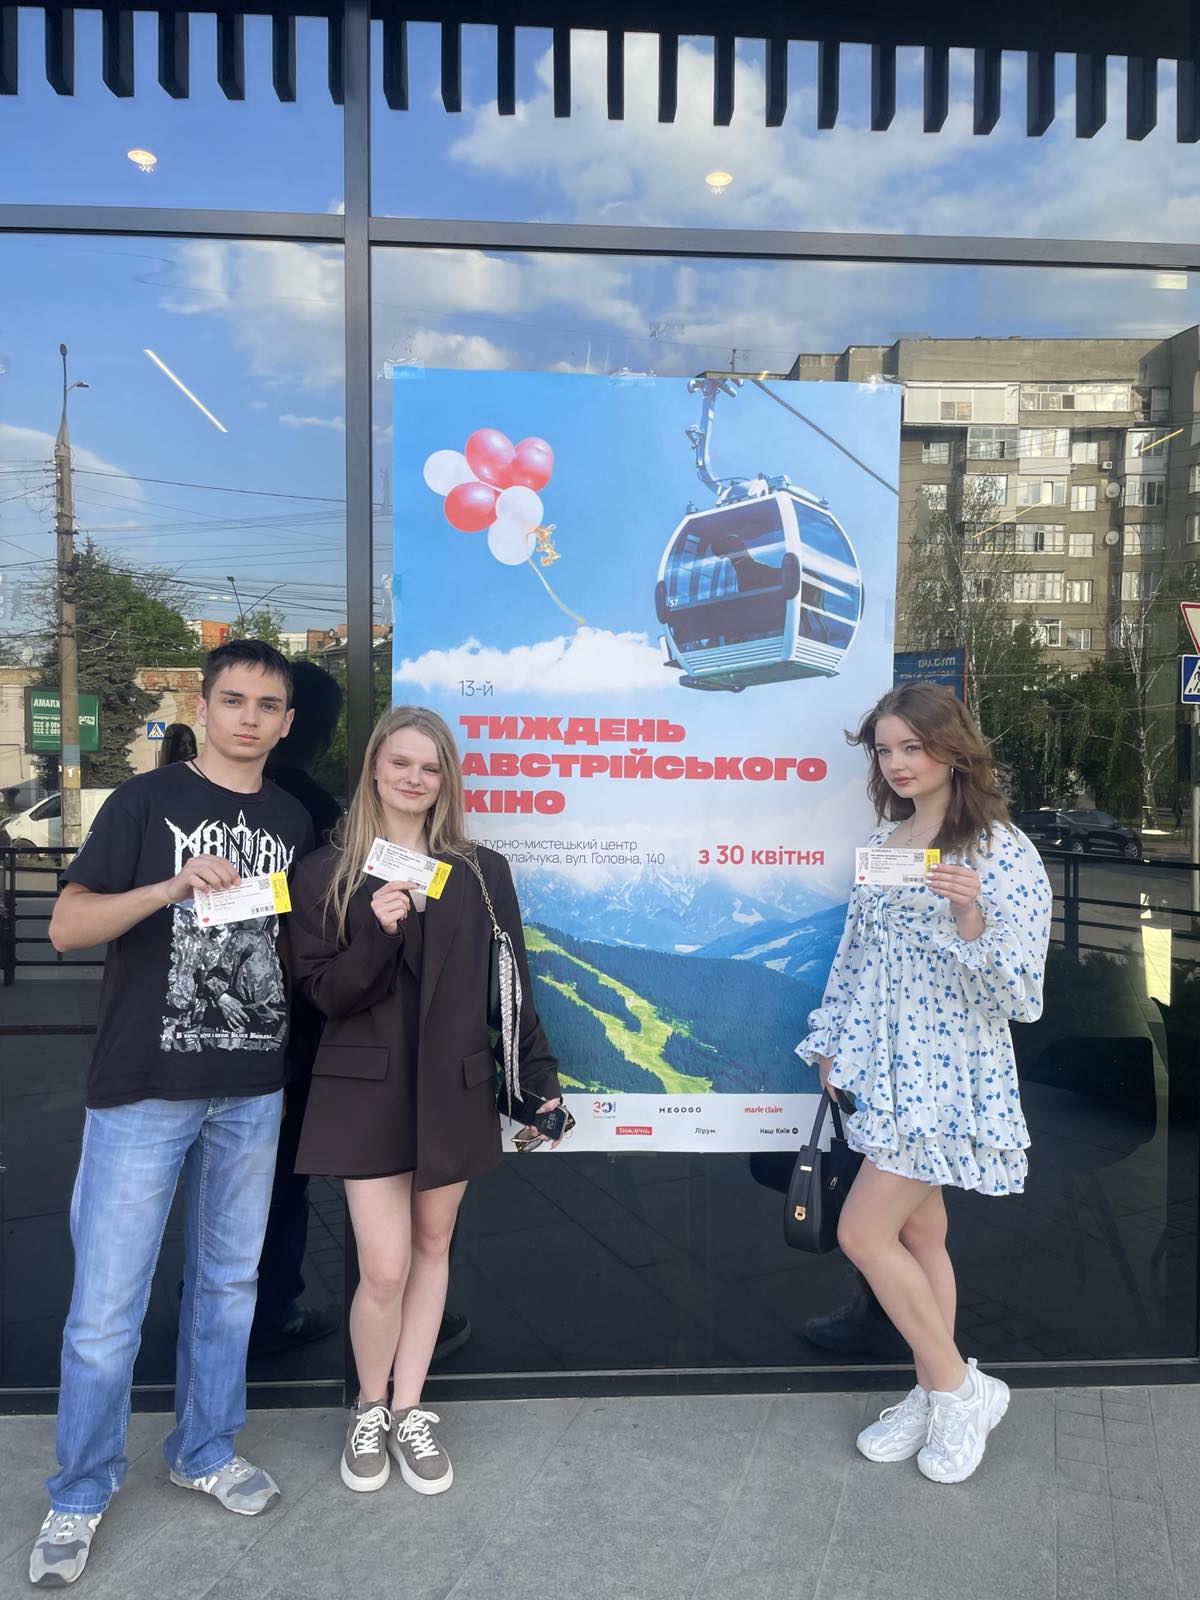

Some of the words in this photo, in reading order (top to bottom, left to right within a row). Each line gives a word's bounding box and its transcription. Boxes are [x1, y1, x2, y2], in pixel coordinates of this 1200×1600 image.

[670, 599, 679, 607] 57
[459, 680, 493, 697] 13-й
[459, 715, 686, 746] ТИЖДЕНЬ
[462, 748, 828, 782] АВСТРІЙСЬКОГО
[464, 789, 566, 814] КІНО
[600, 841, 638, 853] центр
[505, 852, 561, 866] олайчука,
[565, 855, 587, 866] вул.
[591, 853, 642, 866] Головна,
[646, 853, 665, 865] 140
[698, 847, 710, 865] з
[716, 845, 744, 865] 30
[751, 845, 825, 865] квітня
[658, 1106, 702, 1114] MEGOGO
[744, 1106, 764, 1114] marie
[765, 1106, 784, 1114] claire
